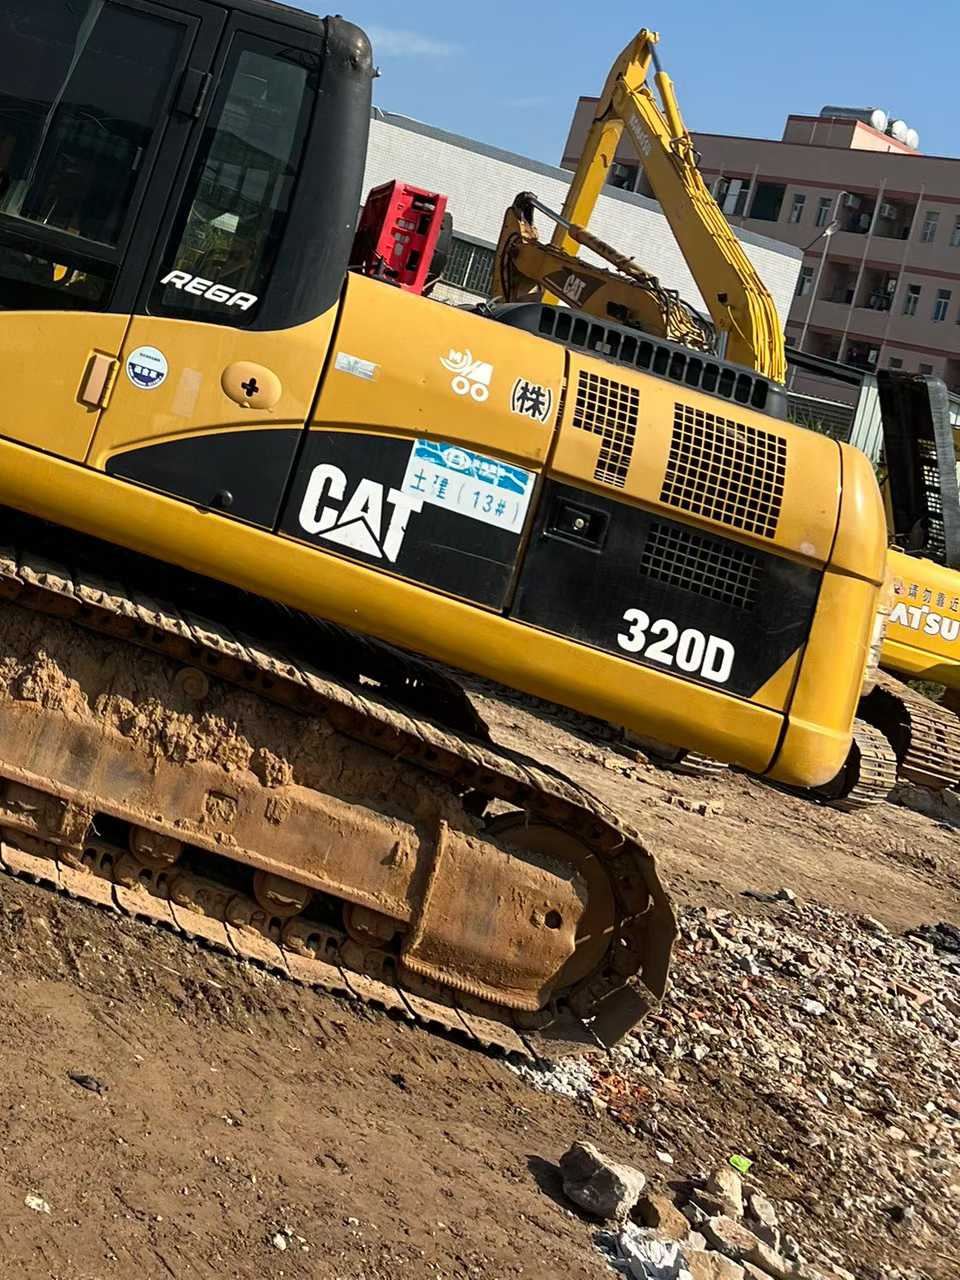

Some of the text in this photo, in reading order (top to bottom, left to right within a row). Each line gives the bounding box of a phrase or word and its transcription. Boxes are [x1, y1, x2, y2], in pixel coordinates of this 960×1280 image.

[160, 270, 259, 312] REGA
[563, 274, 587, 301] CAT
[299, 463, 424, 563] CAT
[617, 608, 736, 683] 320D
